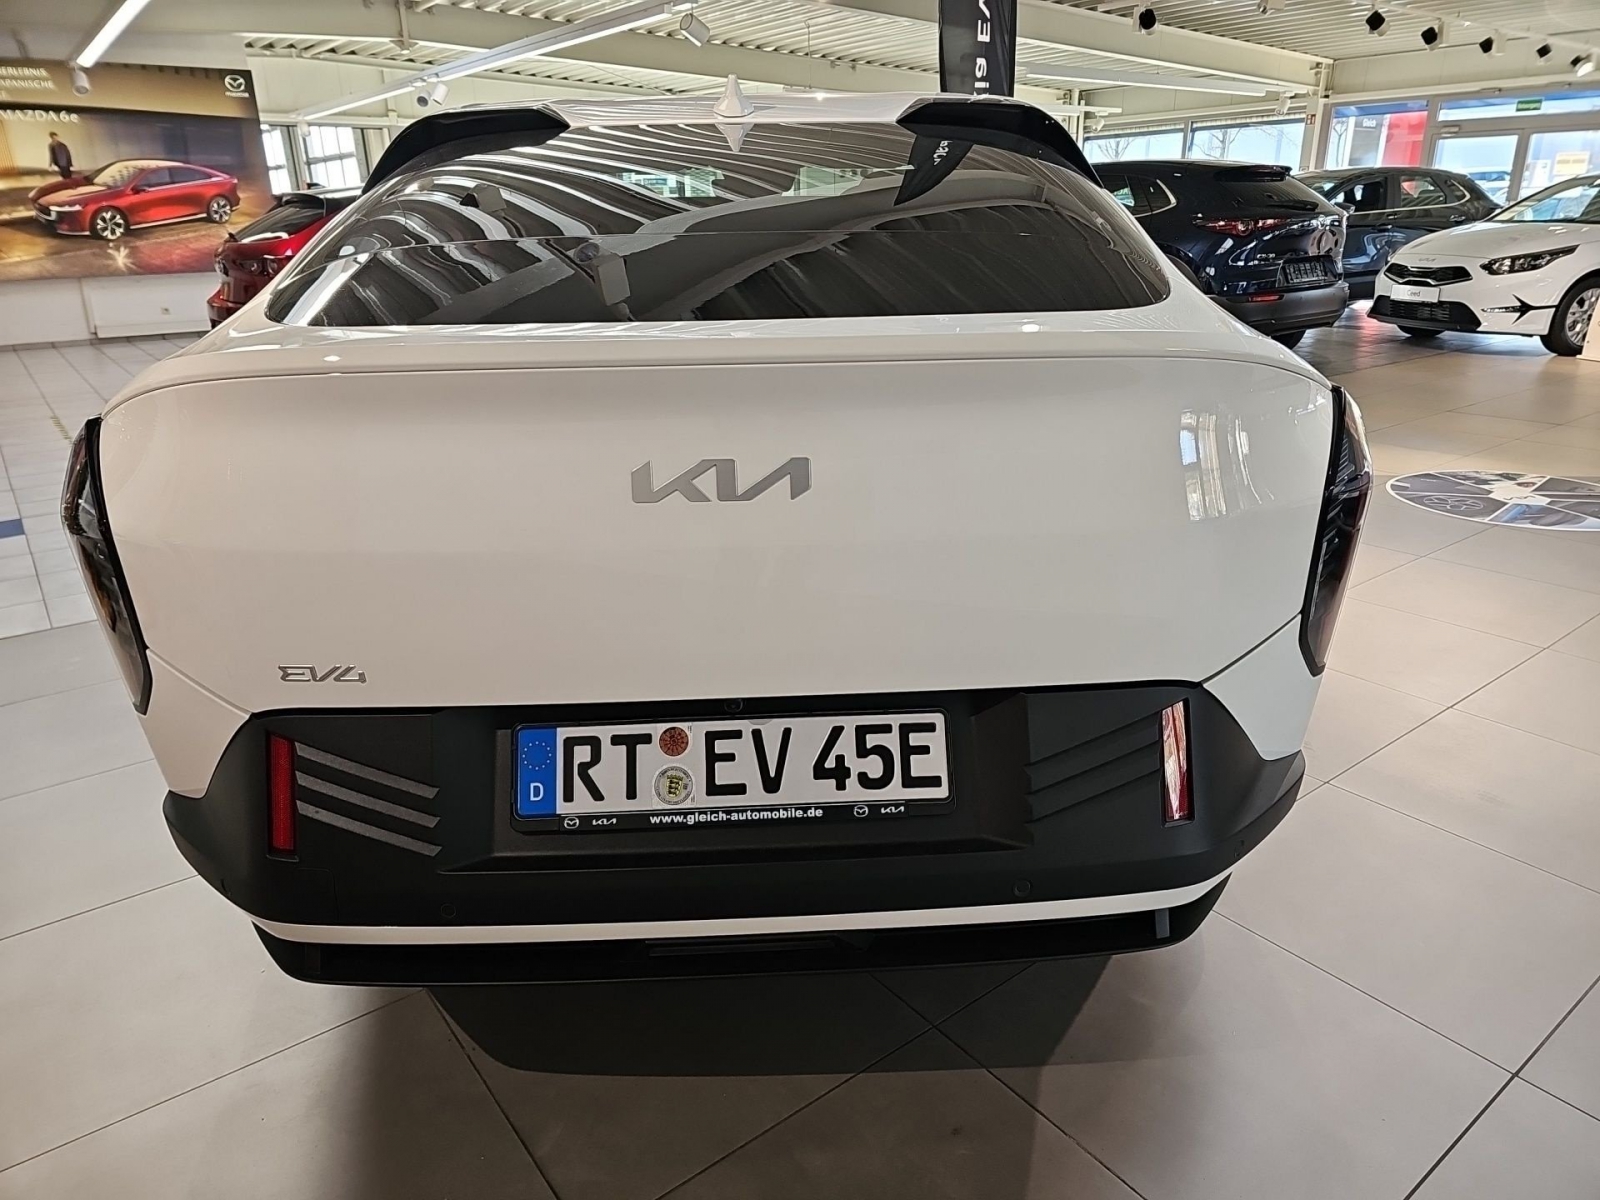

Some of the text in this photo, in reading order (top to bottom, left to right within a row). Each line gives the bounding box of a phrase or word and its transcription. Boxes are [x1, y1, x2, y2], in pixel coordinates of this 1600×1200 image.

[631, 457, 811, 503] KIA
[278, 664, 367, 685] EV4
[563, 733, 653, 803] RT
[705, 727, 793, 796] EV
[813, 722, 942, 791] 45E
[530, 782, 544, 801] D
[649, 807, 824, 825] www.gleich-automobile.de
